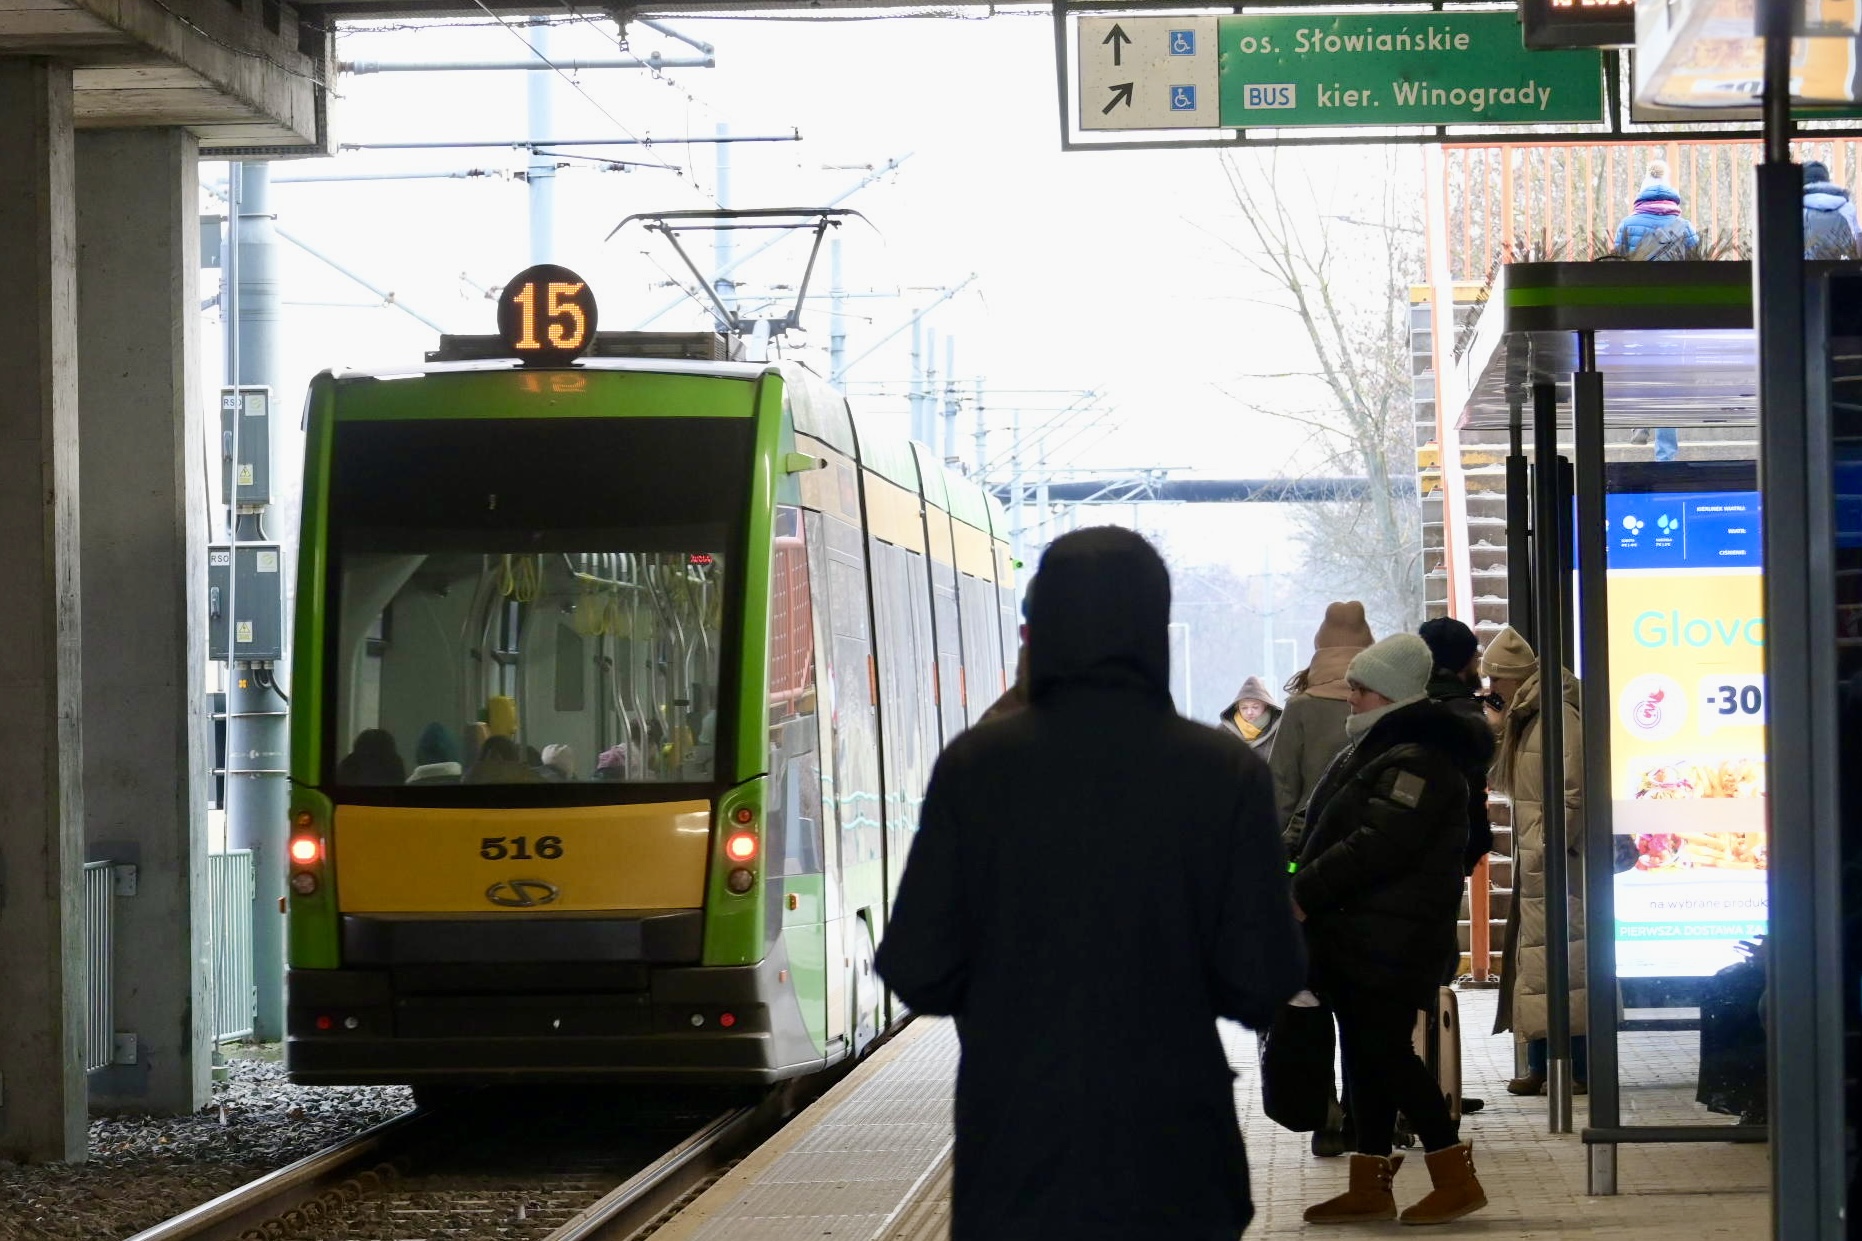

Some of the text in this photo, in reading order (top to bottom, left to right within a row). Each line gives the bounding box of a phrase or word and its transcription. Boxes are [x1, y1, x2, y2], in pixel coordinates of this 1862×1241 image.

[1240, 26, 1470, 53] os. Słowiańskie
[1250, 87, 1290, 106] BUS
[1317, 80, 1551, 112] kier. Winogrady
[513, 282, 585, 349] 15
[211, 555, 229, 563] RSO
[1707, 685, 1762, 715] -30
[480, 835, 563, 860] 516
[1650, 898, 1768, 910] na wybrane produk
[1619, 924, 1764, 937] PIERWSZA DOSTAWA ZA
